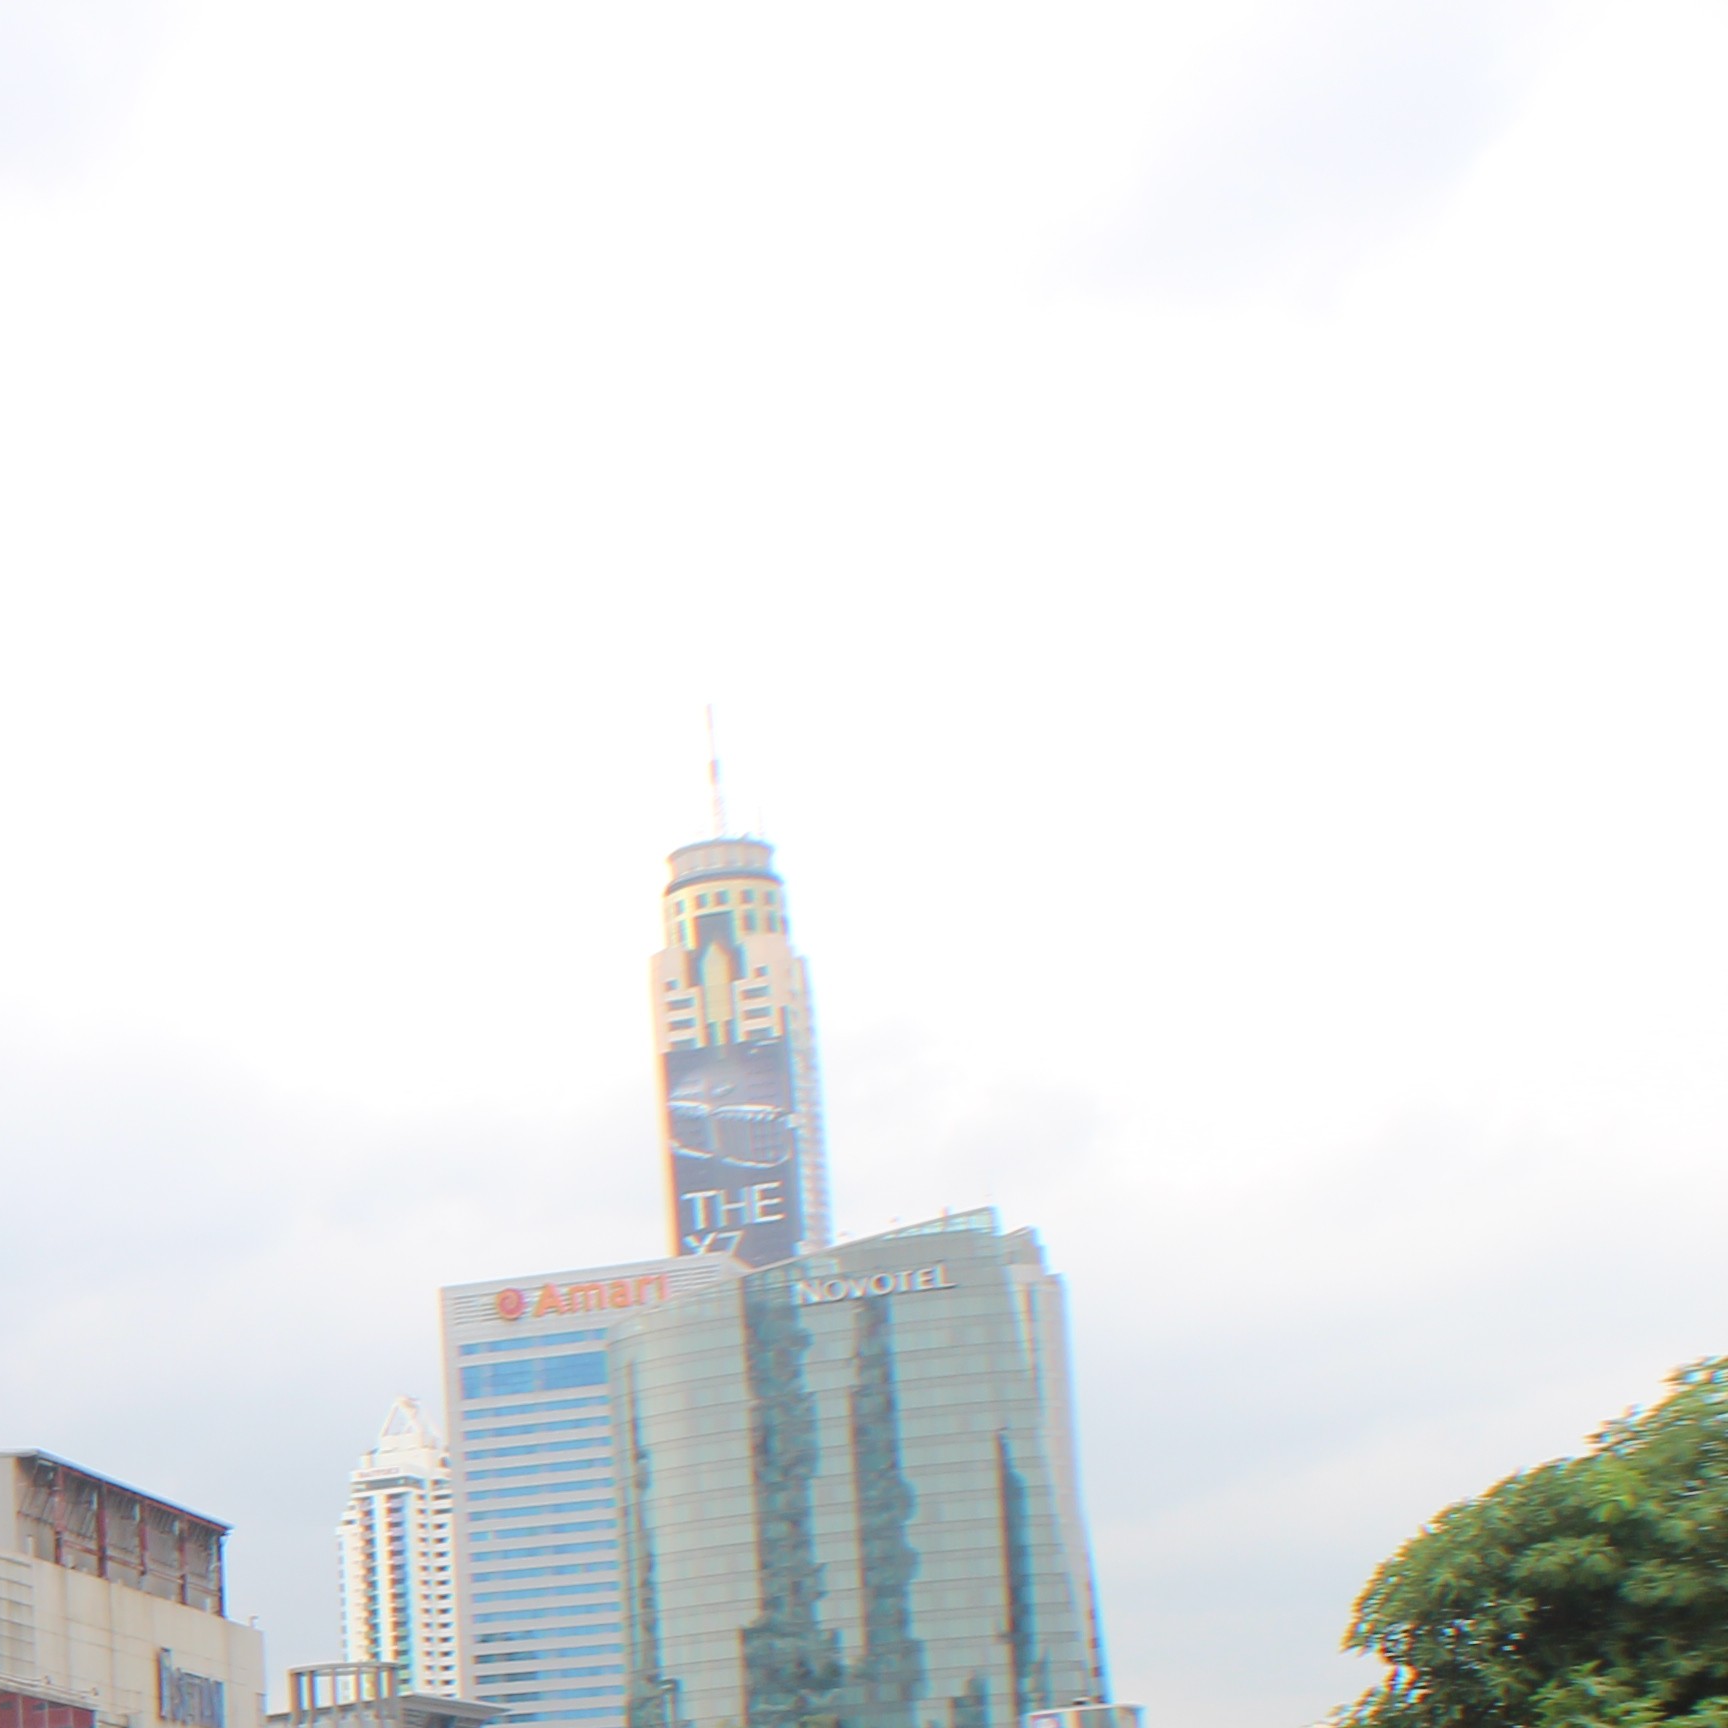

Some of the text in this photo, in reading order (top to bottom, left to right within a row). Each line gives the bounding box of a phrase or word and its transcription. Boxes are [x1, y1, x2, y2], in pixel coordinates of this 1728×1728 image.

[682, 1181, 785, 1228] THE
[534, 1273, 669, 1317] Amari
[797, 1261, 956, 1306] NOVOTEL
